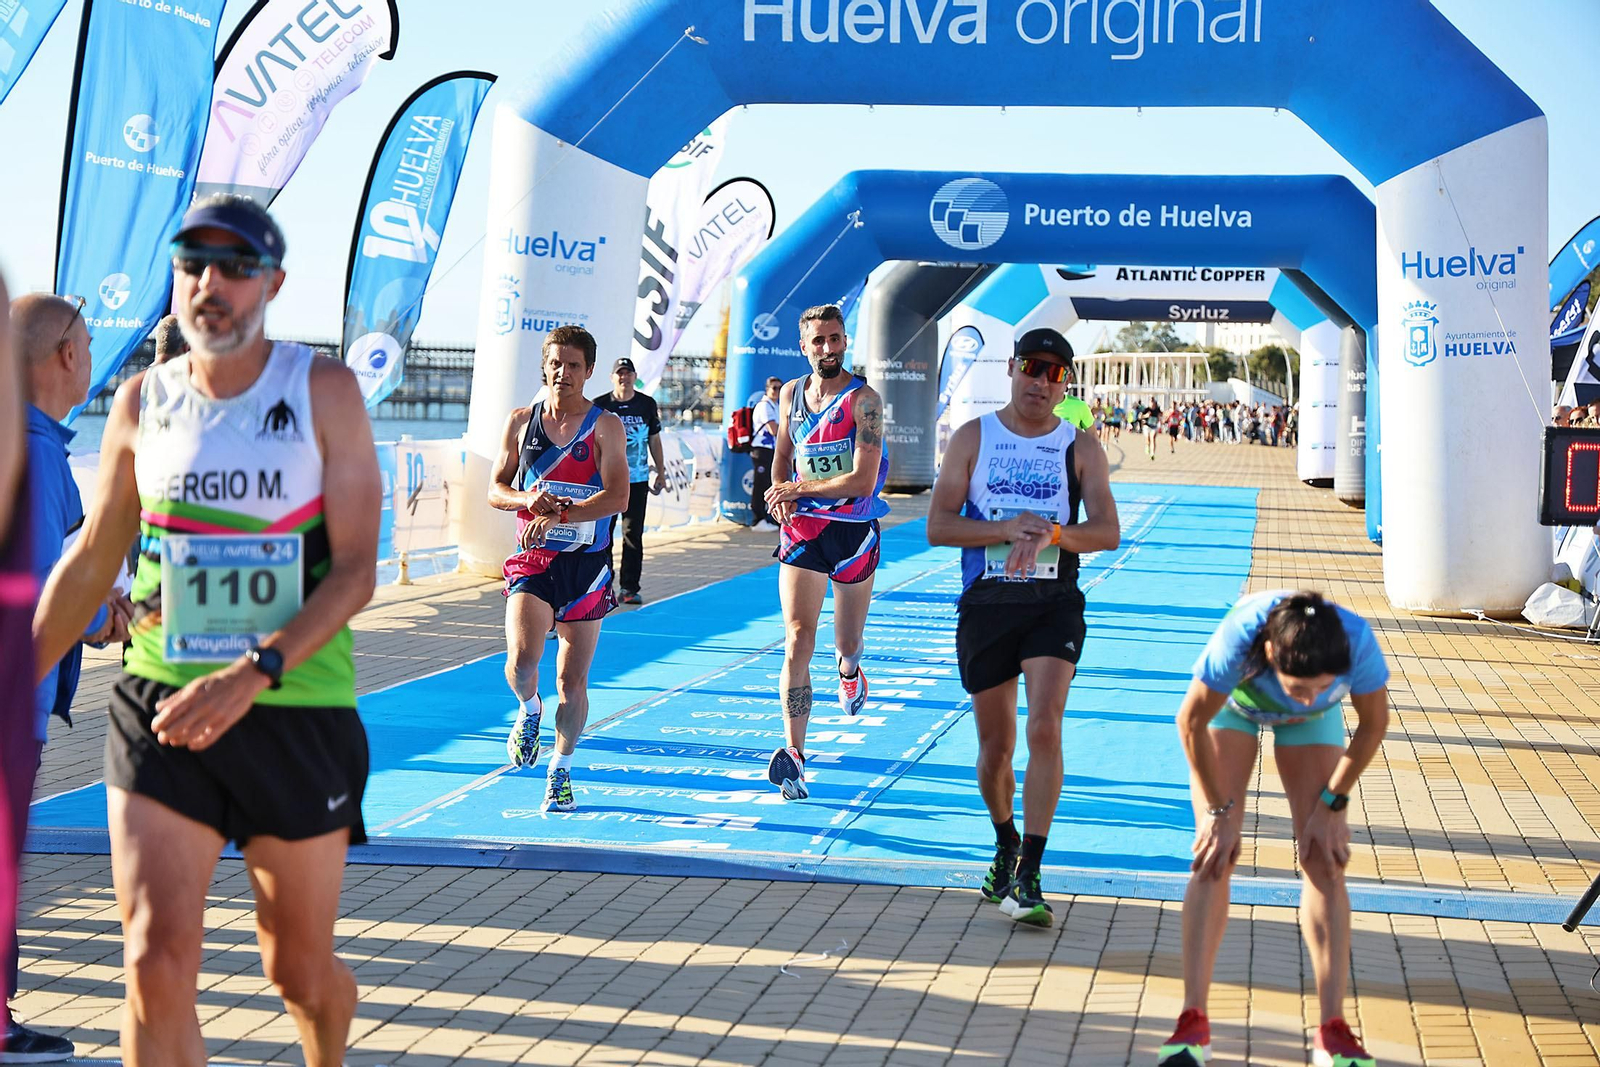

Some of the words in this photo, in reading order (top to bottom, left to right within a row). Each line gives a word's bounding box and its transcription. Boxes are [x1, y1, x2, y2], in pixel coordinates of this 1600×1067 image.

[155, 1, 171, 13] de
[174, 5, 211, 28] Huelva
[743, 0, 988, 44] Huelva
[1014, 0, 1262, 60] original
[312, 14, 375, 70] TELECOM
[213, 0, 363, 143] AVATEL
[679, 136, 714, 159] SIF
[85, 151, 125, 168] Puerto
[128, 159, 143, 171] de
[146, 163, 185, 178] Huelva
[390, 115, 442, 207] HUELVA
[1024, 203, 1111, 227] Puerto
[1118, 202, 1151, 227] de
[1159, 204, 1252, 229] Huelva
[688, 198, 757, 259] VATEL
[501, 228, 596, 262] Huelva
[555, 264, 594, 276] original
[1116, 266, 1197, 282] ATLANTIC
[1200, 267, 1265, 282] COPPER
[1402, 247, 1516, 279] Huelva
[634, 206, 679, 351] CSIF
[1476, 278, 1516, 292] original
[523, 307, 577, 319] Ayuntamiento
[1169, 304, 1230, 322] Syrluz
[521, 317, 586, 333] HUE
[1445, 331, 1505, 342] Ayuntamiento
[1507, 330, 1517, 338] de
[757, 346, 769, 355] de
[771, 346, 801, 357] Huelva
[1445, 341, 1516, 357] HUELVA
[1347, 370, 1366, 381] Hue
[884, 425, 924, 435] PUTACIÓN
[807, 455, 843, 473] 131
[988, 457, 1062, 474] RUNNERS
[1006, 461, 1060, 484] Palmera
[258, 469, 287, 500] M.
[549, 528, 573, 537] ayalia
[186, 568, 277, 606] 110
